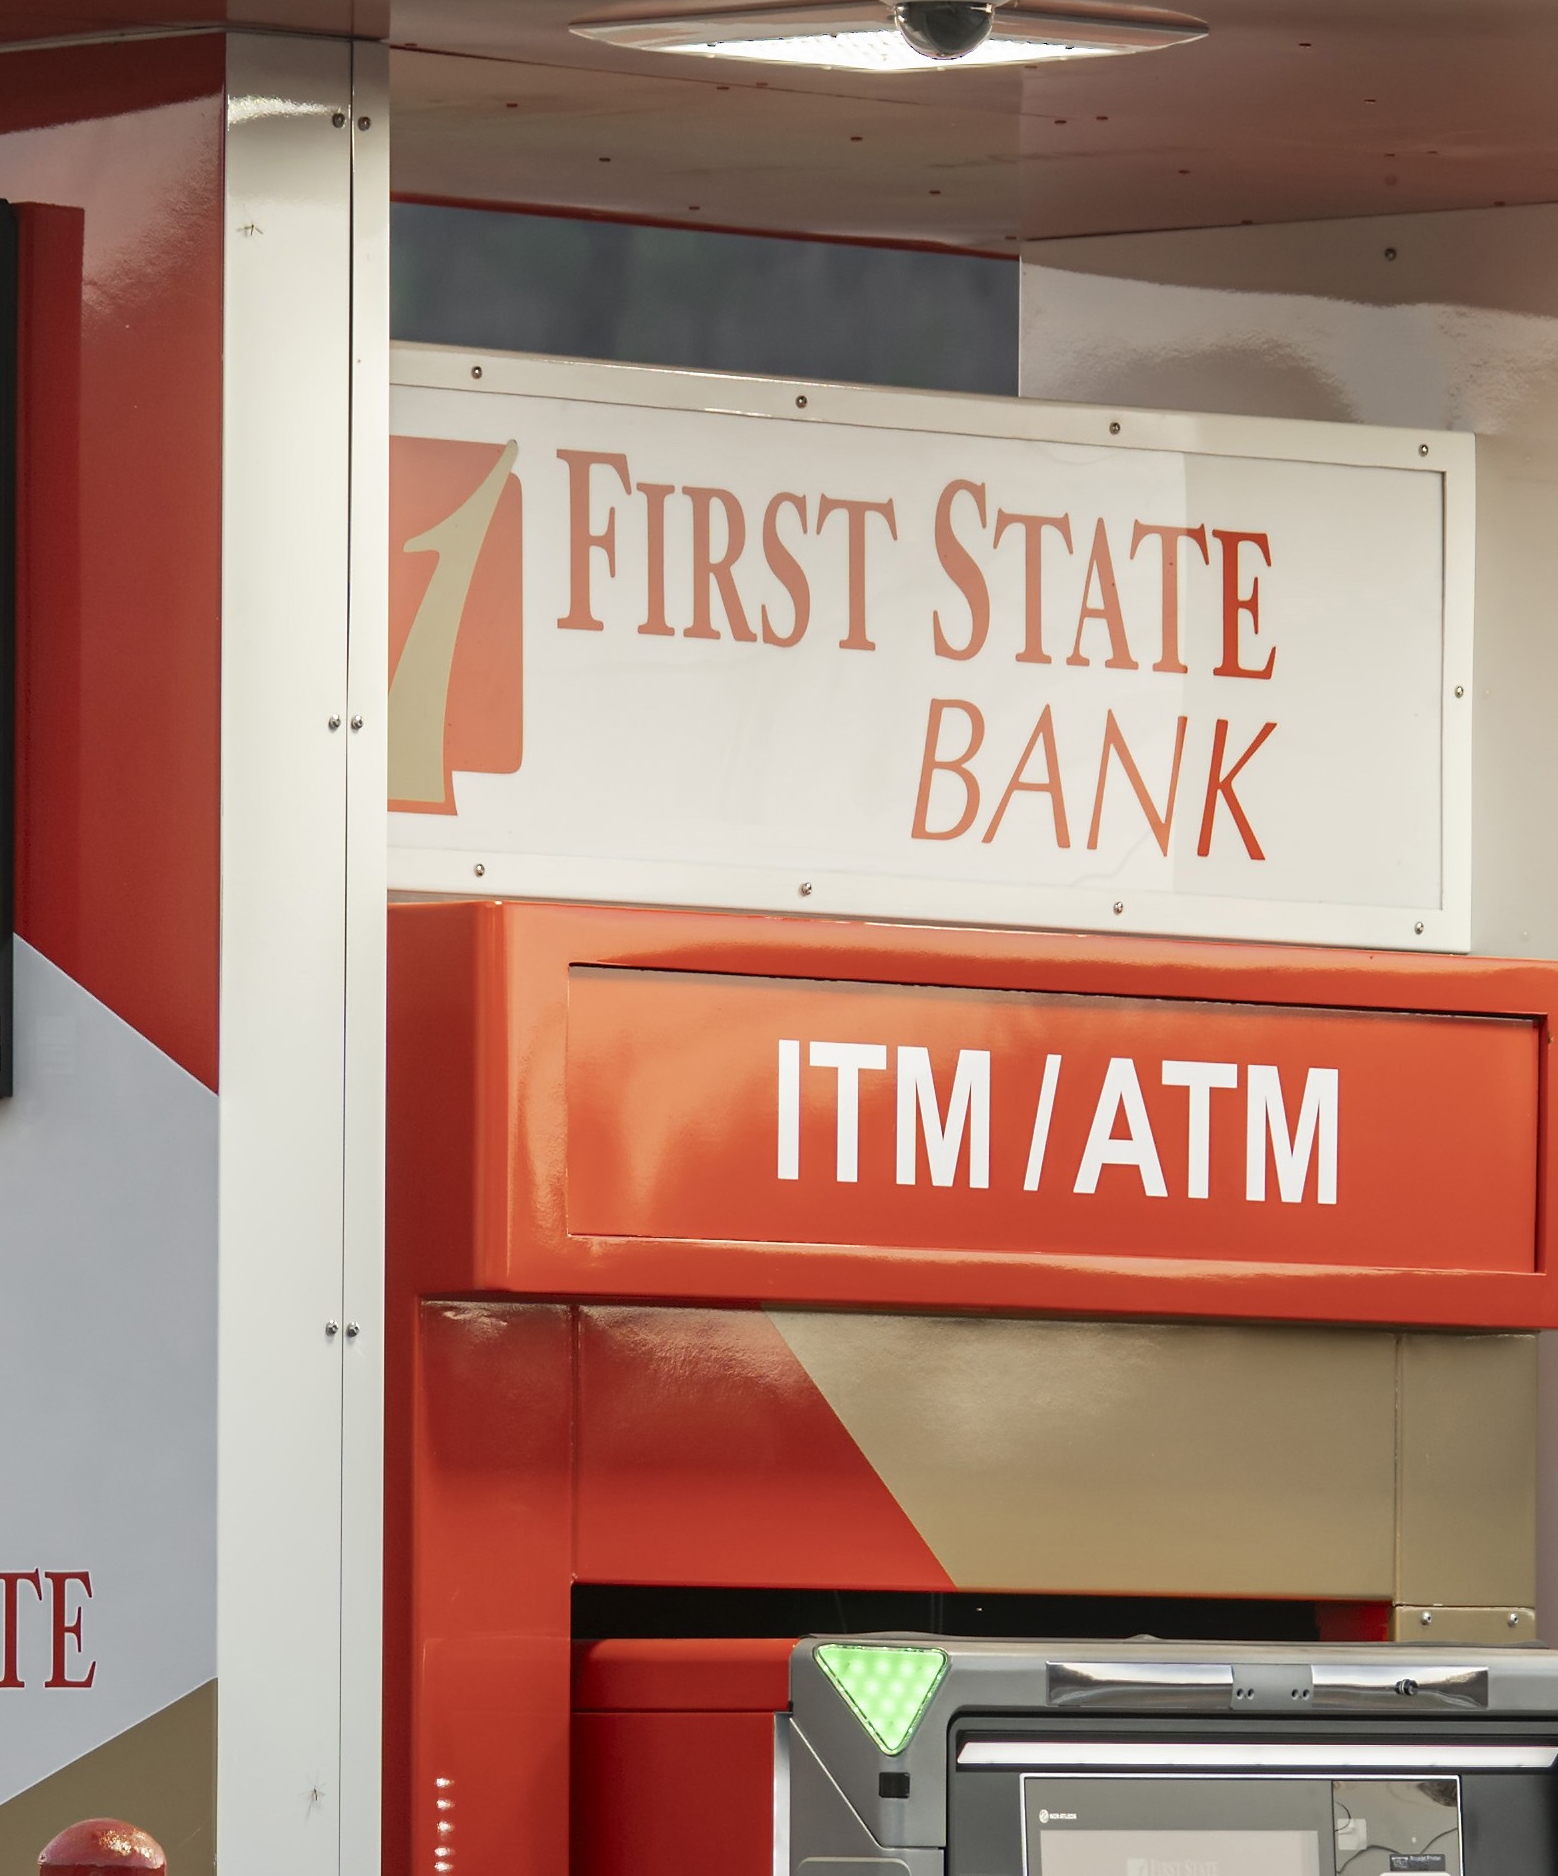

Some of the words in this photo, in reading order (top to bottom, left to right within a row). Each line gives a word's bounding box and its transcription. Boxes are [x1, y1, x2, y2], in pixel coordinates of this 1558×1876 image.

[556, 448, 896, 652] FIRST
[933, 478, 1277, 680] STATE
[910, 698, 1278, 861] BANK
